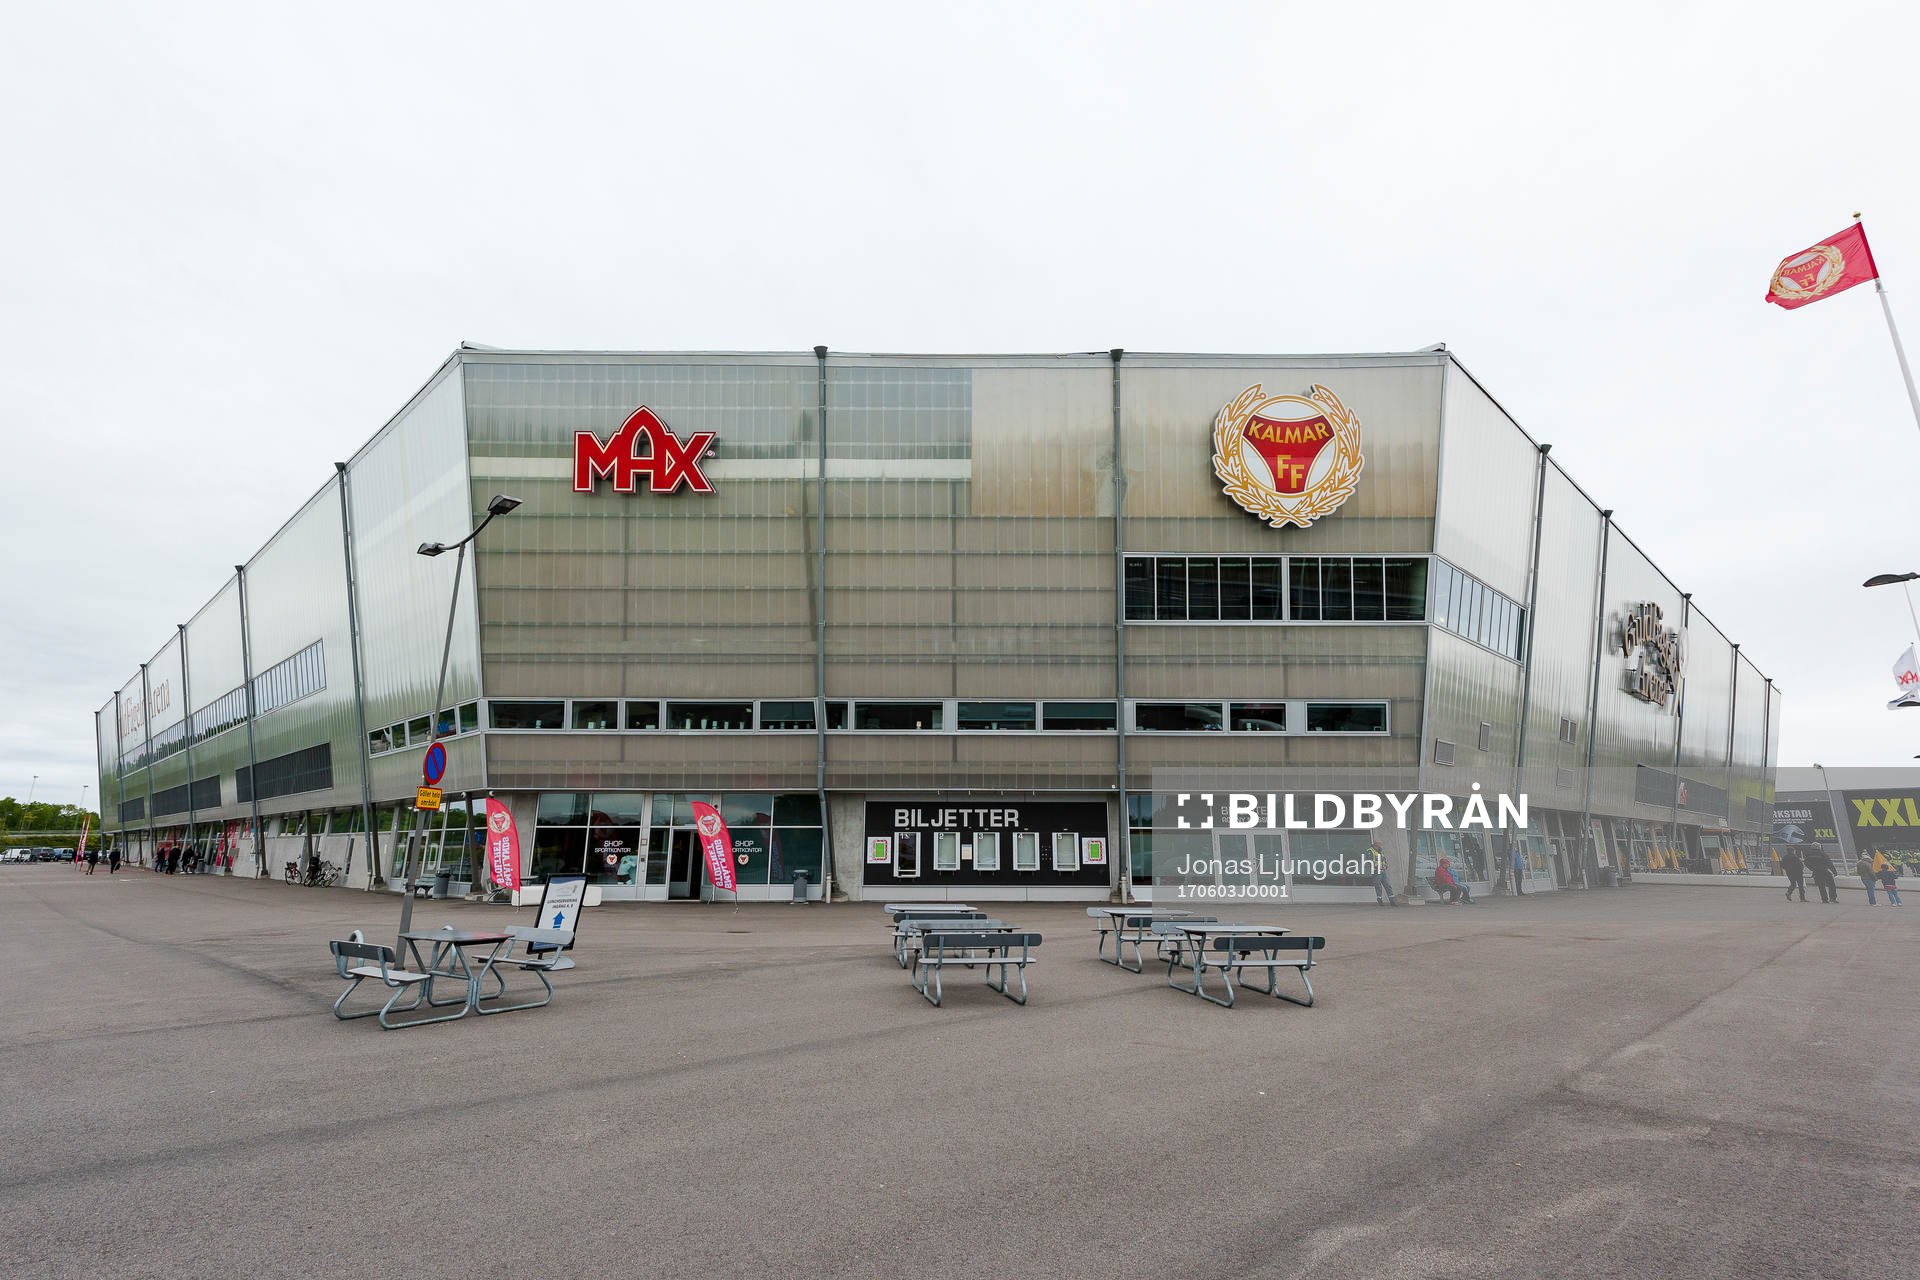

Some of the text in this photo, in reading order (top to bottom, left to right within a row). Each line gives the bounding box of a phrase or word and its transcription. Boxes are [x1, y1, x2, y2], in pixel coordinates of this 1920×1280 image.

[1248, 420, 1330, 444] KALMAR
[573, 405, 717, 493] MAX
[1277, 454, 1305, 489] FF
[894, 808, 1020, 828] BILJETTER
[1773, 809, 1813, 818] RKSTAD!
[1851, 798, 1920, 827] XXL
[1814, 828, 1836, 838] XXL
